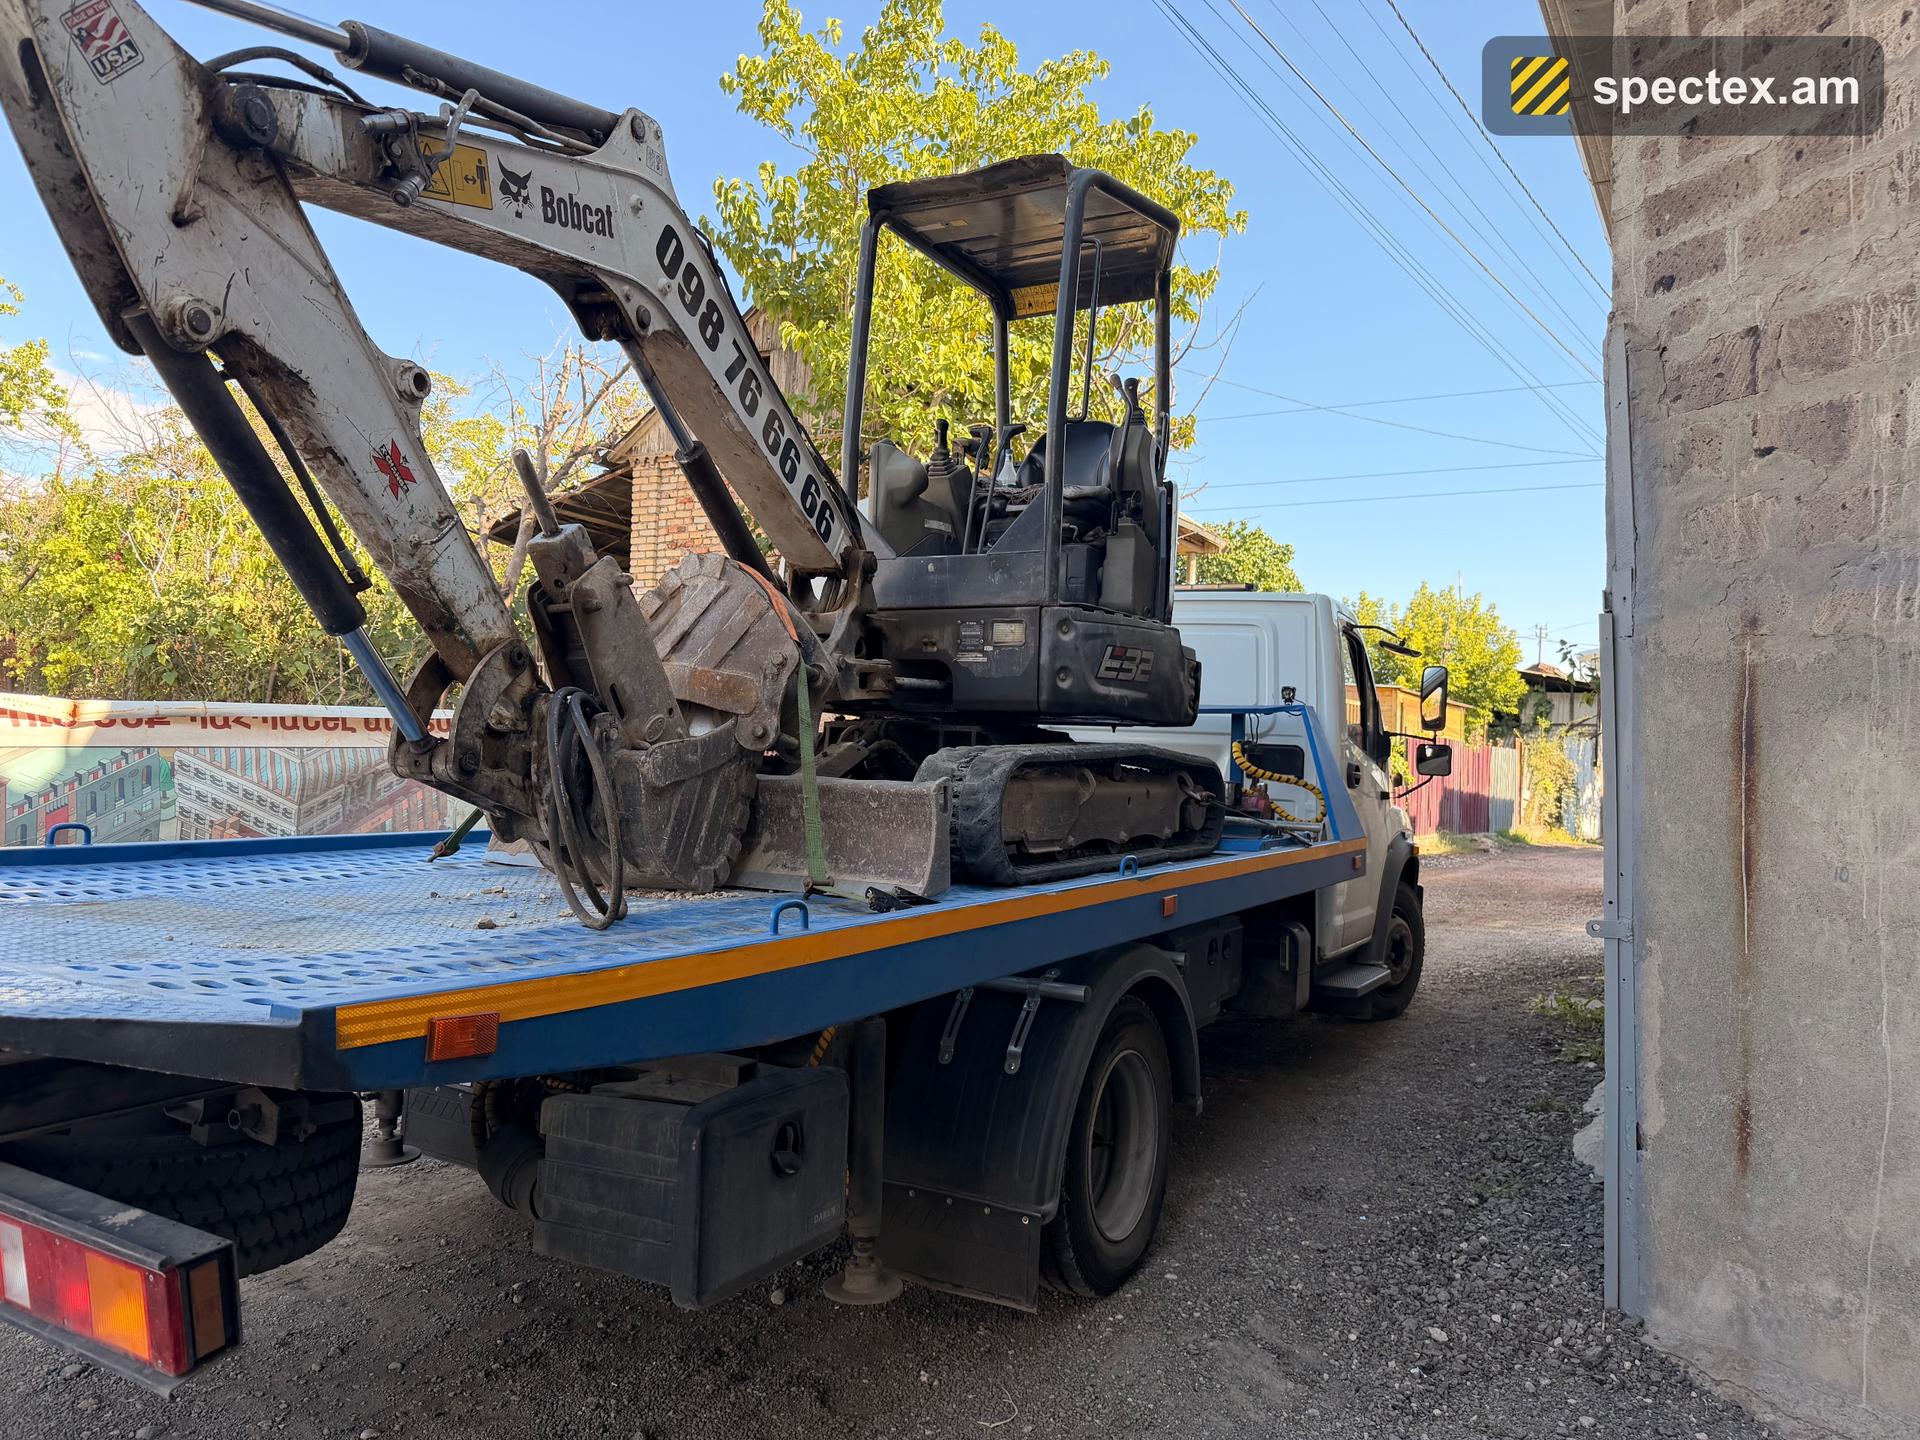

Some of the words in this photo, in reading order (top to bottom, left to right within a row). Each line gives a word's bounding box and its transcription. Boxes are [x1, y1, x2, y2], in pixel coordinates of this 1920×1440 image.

[92, 43, 137, 75] USA
[540, 185, 614, 239] Bobcat
[656, 224, 725, 352] 098
[724, 337, 763, 418] 76
[762, 408, 802, 485] 66
[800, 473, 836, 544] 66
[1096, 646, 1154, 682] E32
